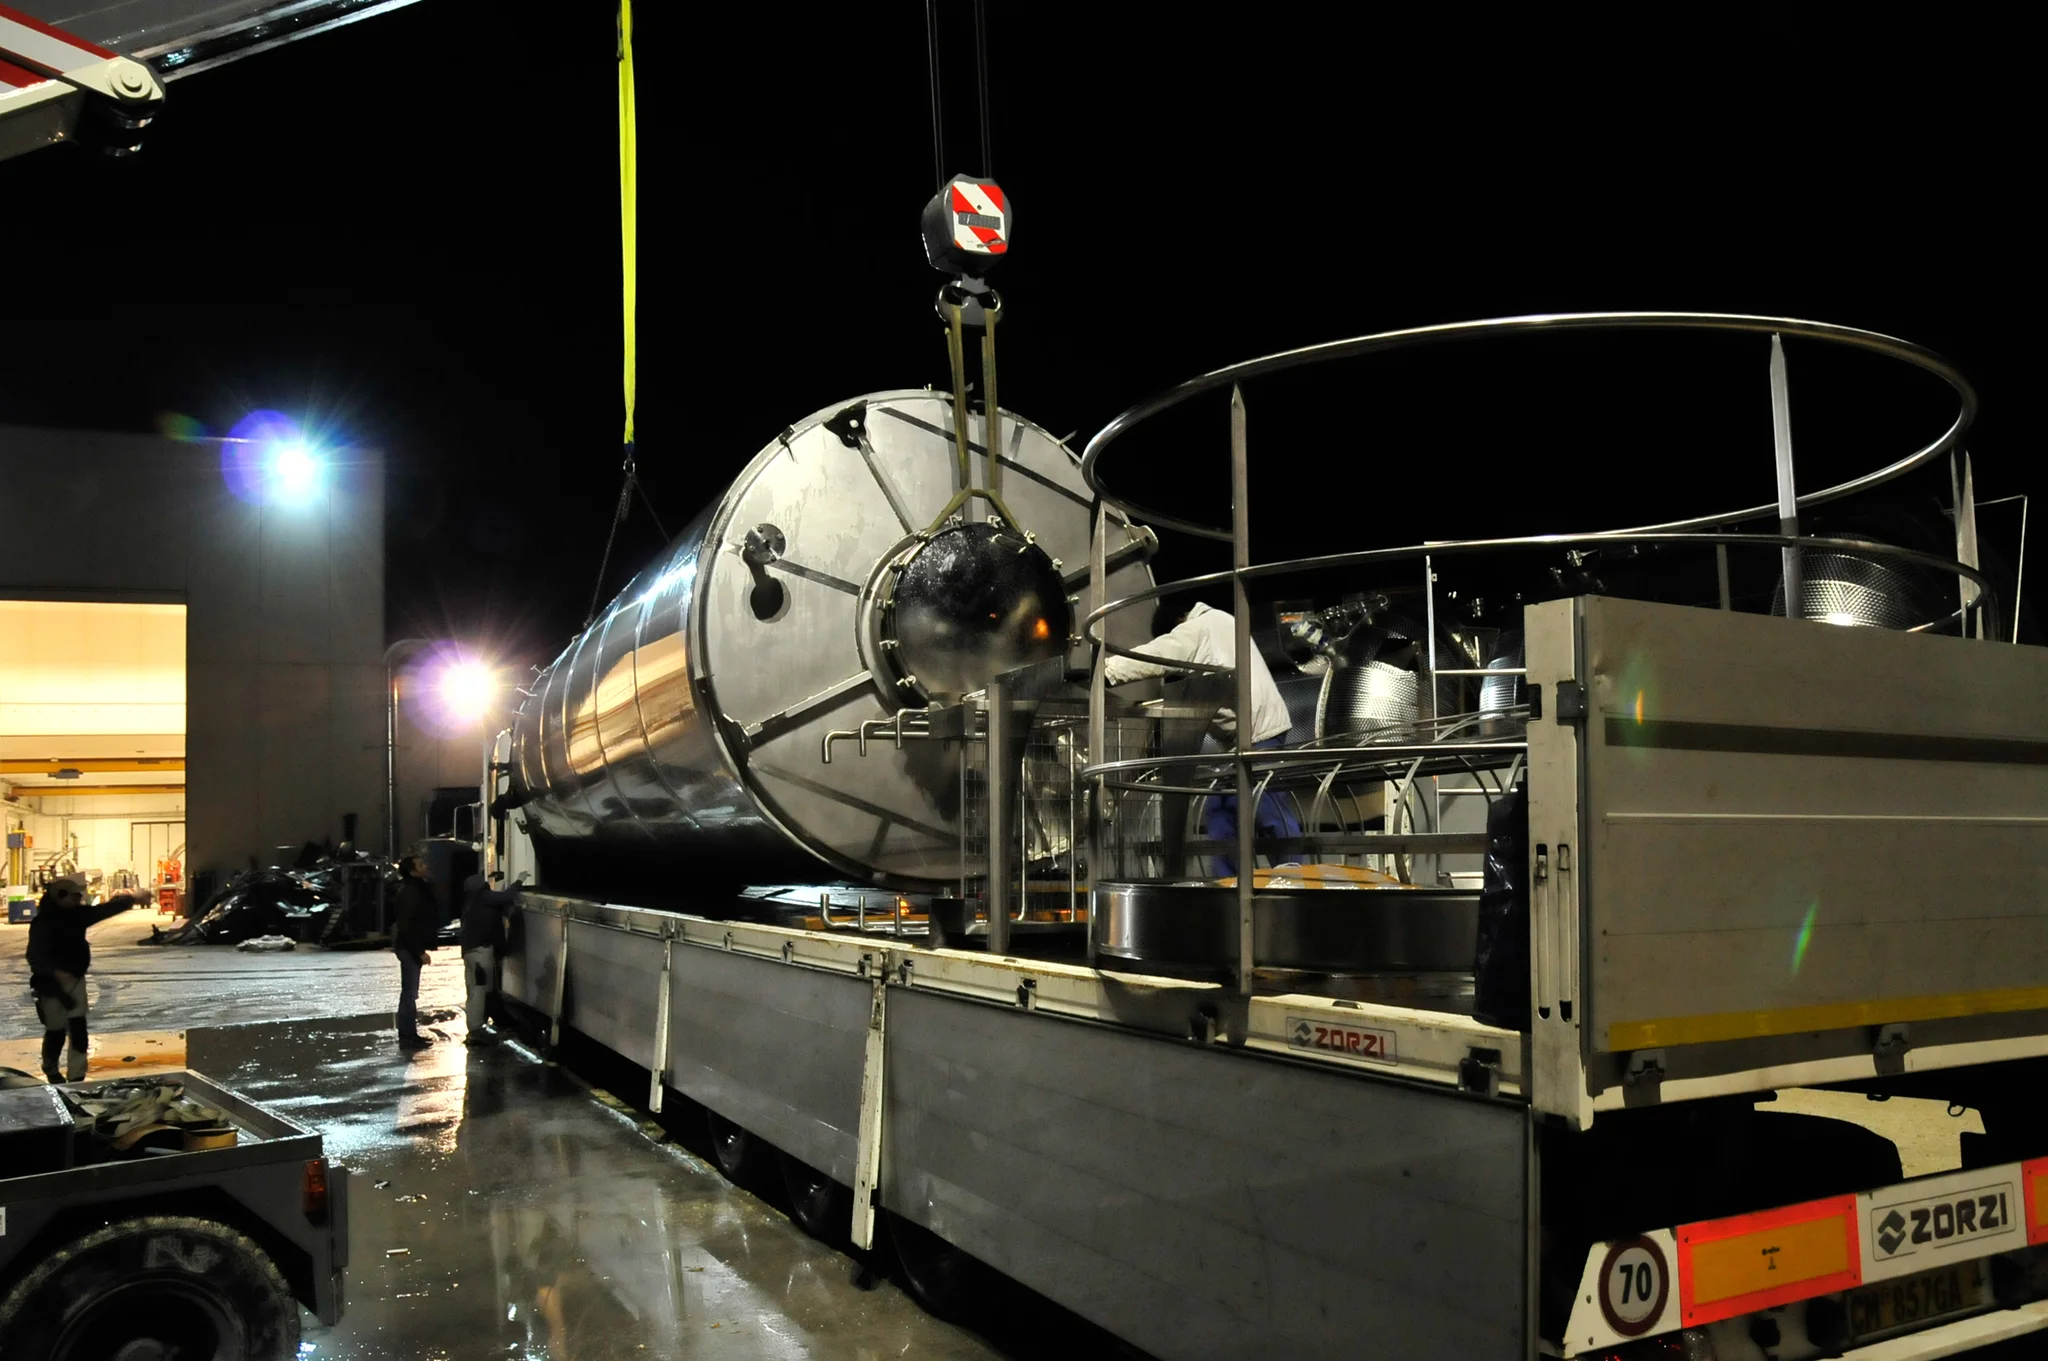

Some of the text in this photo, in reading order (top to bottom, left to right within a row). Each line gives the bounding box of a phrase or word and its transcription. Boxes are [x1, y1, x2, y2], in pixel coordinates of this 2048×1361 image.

[1315, 1027, 1384, 1059] ZORZI
[1911, 1192, 2008, 1244] ZORZI
[1620, 1262, 1652, 1304] 70
